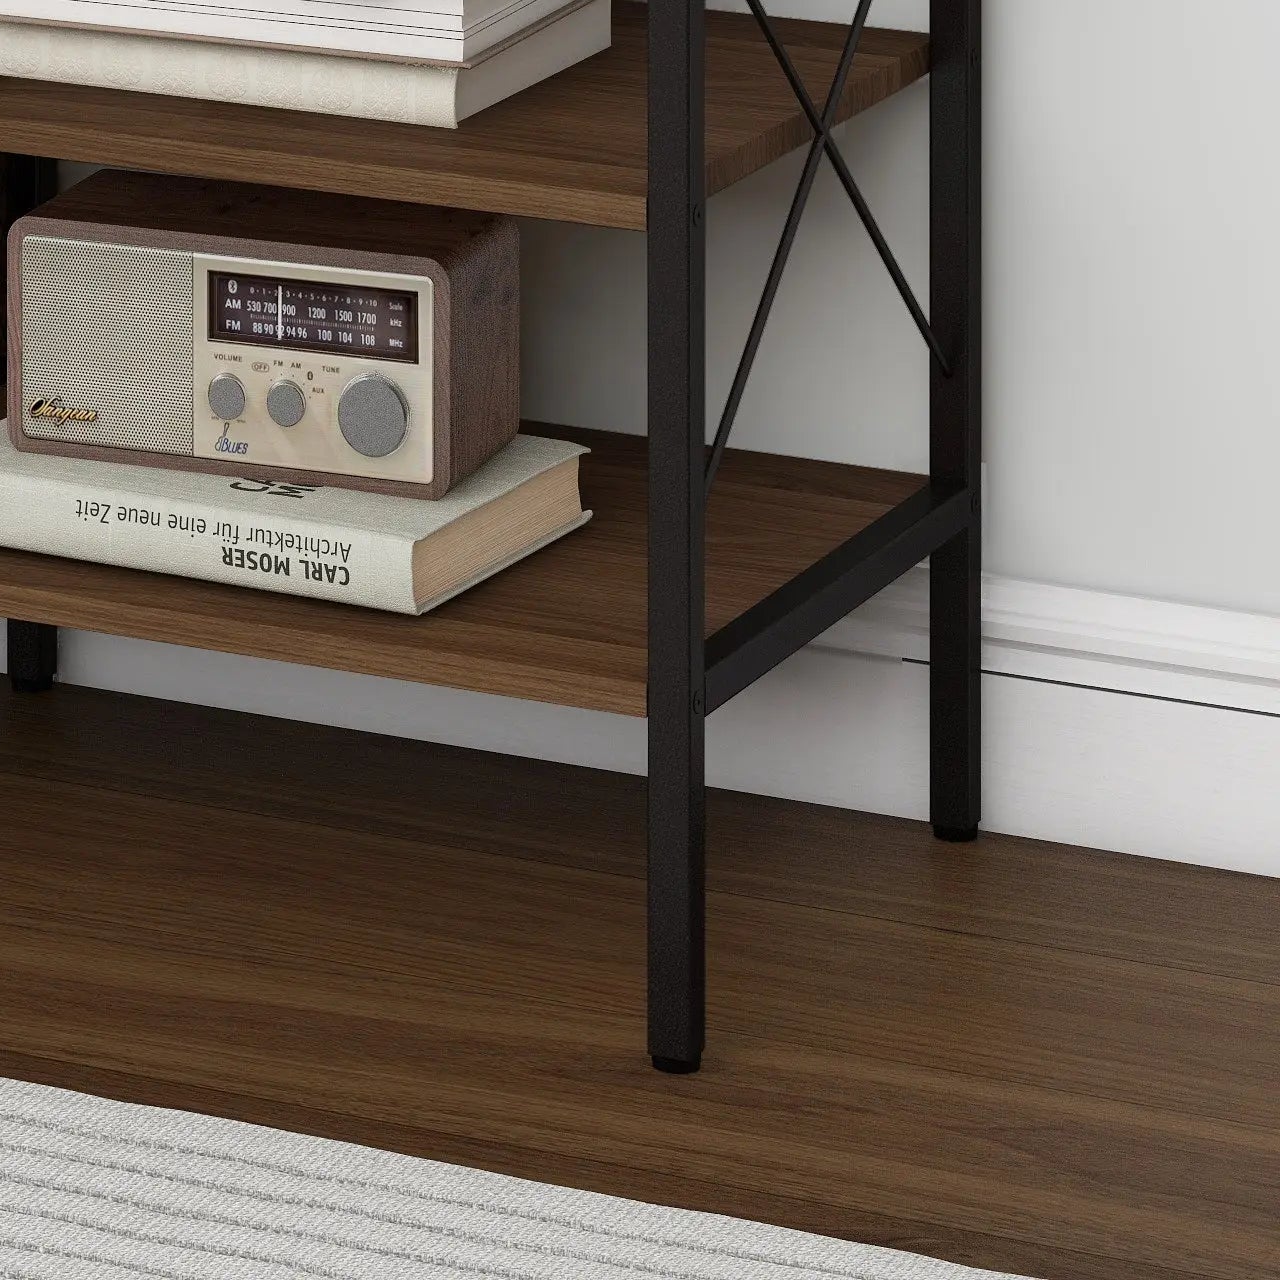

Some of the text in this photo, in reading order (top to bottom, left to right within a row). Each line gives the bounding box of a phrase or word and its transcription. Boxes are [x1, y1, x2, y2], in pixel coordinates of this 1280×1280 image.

[225, 298, 402, 327] AM 530 700 900 1200 1500 1700 kHz
[225, 319, 241, 330] FM
[252, 322, 262, 334] 88
[264, 323, 274, 335] 90
[286, 326, 296, 337] 94
[297, 327, 307, 339] 96
[317, 329, 332, 341] 100
[338, 331, 352, 343] 104
[361, 333, 376, 346] 108
[389, 338, 403, 348] MHz
[214, 353, 243, 362] VOLUME
[75, 499, 352, 564] Architektur für eine neue Zeit
[220, 546, 351, 586] CARL MOSER
